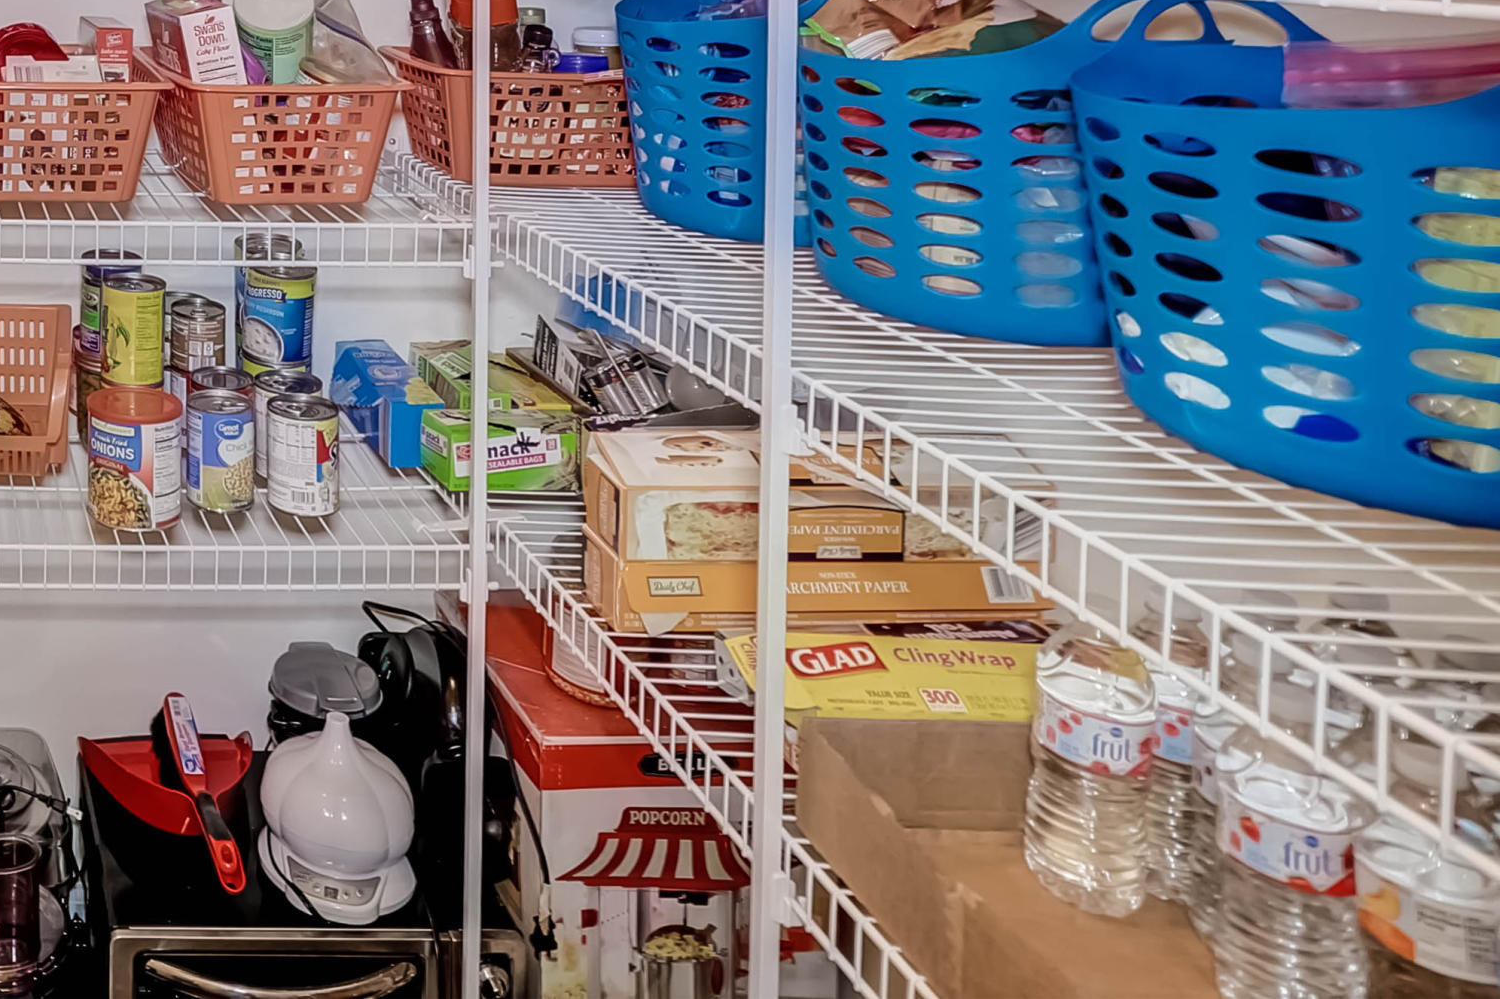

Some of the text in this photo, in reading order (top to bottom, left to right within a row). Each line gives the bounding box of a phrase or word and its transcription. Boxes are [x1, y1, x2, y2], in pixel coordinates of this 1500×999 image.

[193, 22, 225, 37] Swans
[198, 32, 226, 47] Down
[91, 438, 135, 461] ONIONS
[788, 525, 820, 535] PAPE
[786, 581, 911, 595] ARCHMENT PAPER
[791, 646, 876, 675] GLAD
[922, 690, 959, 705] 300
[629, 810, 706, 825] POPCORN
